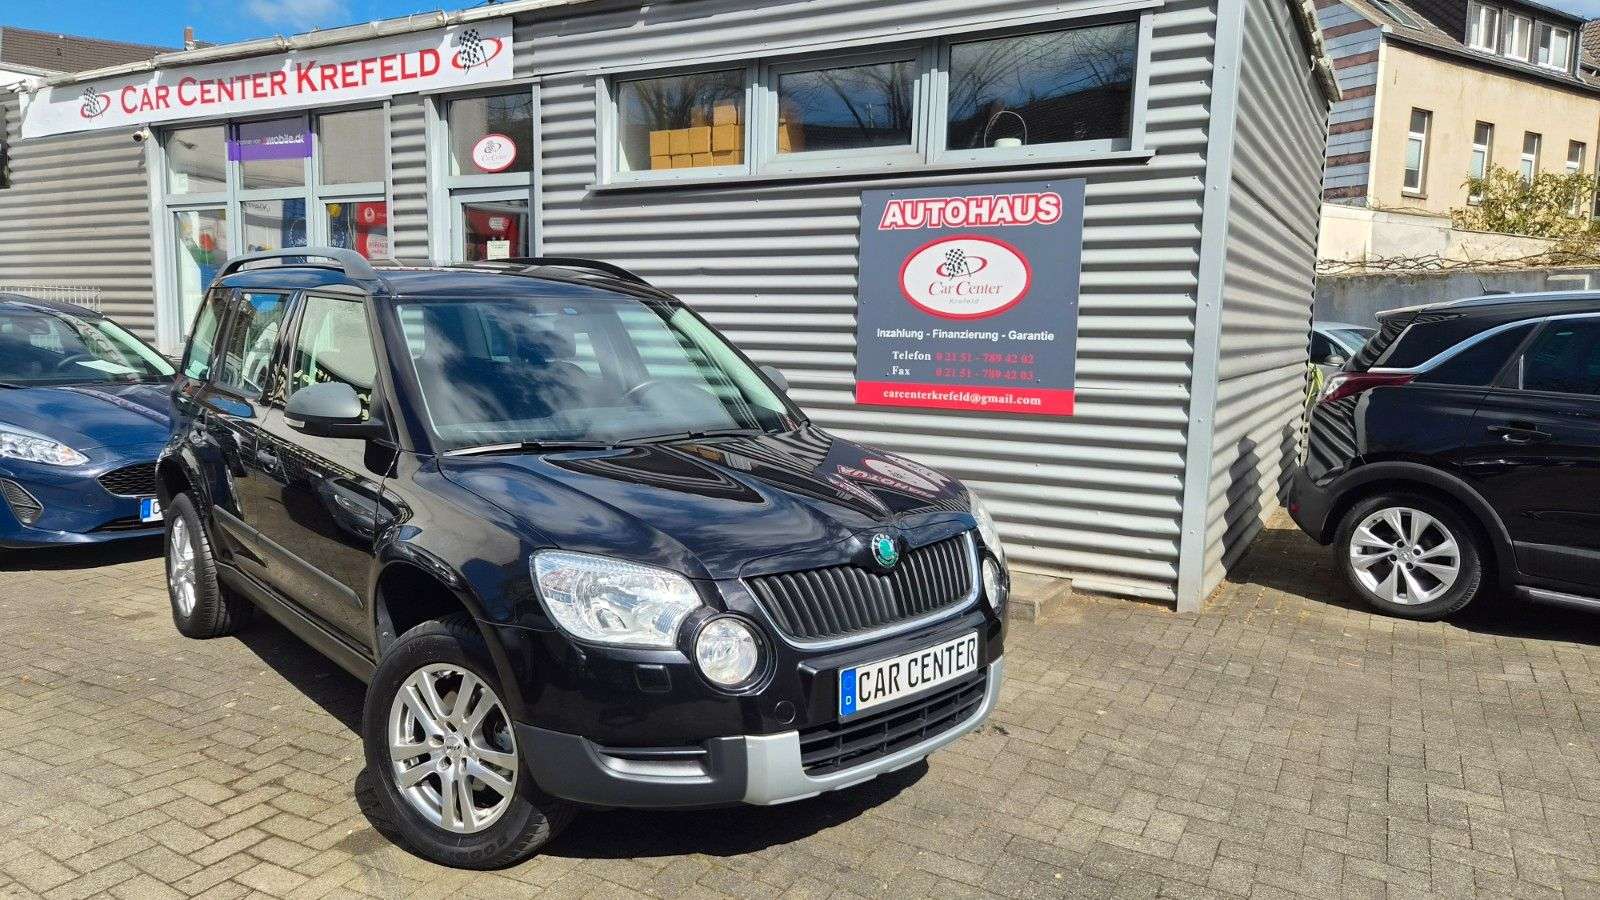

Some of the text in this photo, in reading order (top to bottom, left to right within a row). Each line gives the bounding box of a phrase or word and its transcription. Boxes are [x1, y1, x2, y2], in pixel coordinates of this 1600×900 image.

[120, 48, 441, 114] CAR CENTER KREFELD
[879, 192, 1062, 230] AUTOHAUS
[928, 280, 1003, 296] Car Center
[877, 328, 923, 340] Inzahlung
[932, 329, 998, 341] Finanzierung
[1008, 330, 1054, 341] Garantie
[892, 351, 931, 361] Telefon
[892, 366, 911, 376] Fax
[883, 388, 1041, 406] carcenterkrefeld@gmail.com
[845, 637, 976, 705] D CAR CENTER
